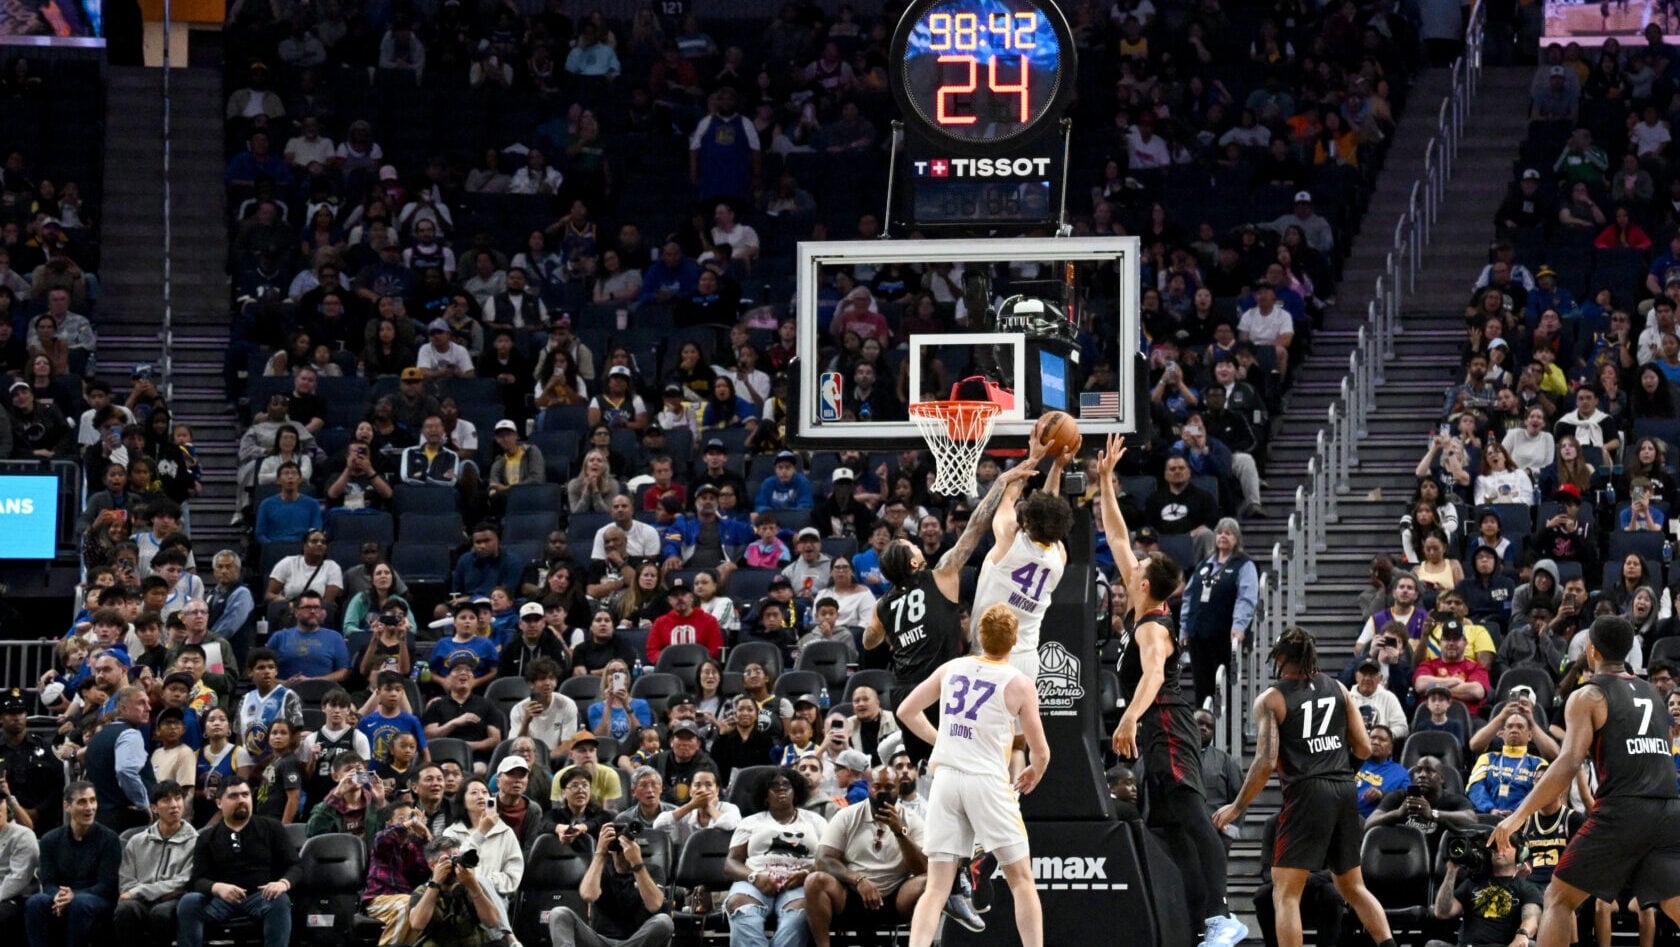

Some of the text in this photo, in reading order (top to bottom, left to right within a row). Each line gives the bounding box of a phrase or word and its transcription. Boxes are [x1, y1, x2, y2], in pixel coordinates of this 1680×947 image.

[662, 1, 682, 14] 121
[929, 13, 1037, 50] 98:42
[937, 54, 1029, 124] 24
[951, 158, 1050, 177] TISSOT
[1011, 562, 1051, 601] 41
[890, 588, 926, 633] 78
[1008, 591, 1038, 613] WATSON
[899, 625, 926, 647] WHITE
[944, 674, 997, 720] 37
[1037, 681, 1081, 699] lifornia
[1038, 698, 1071, 706] LASSIC
[1301, 696, 1336, 738] 17
[1633, 697, 1653, 735] 7
[1307, 735, 1342, 754] YOUNG
[1626, 737, 1672, 757] CONWELL
[1532, 848, 1559, 868] 23
